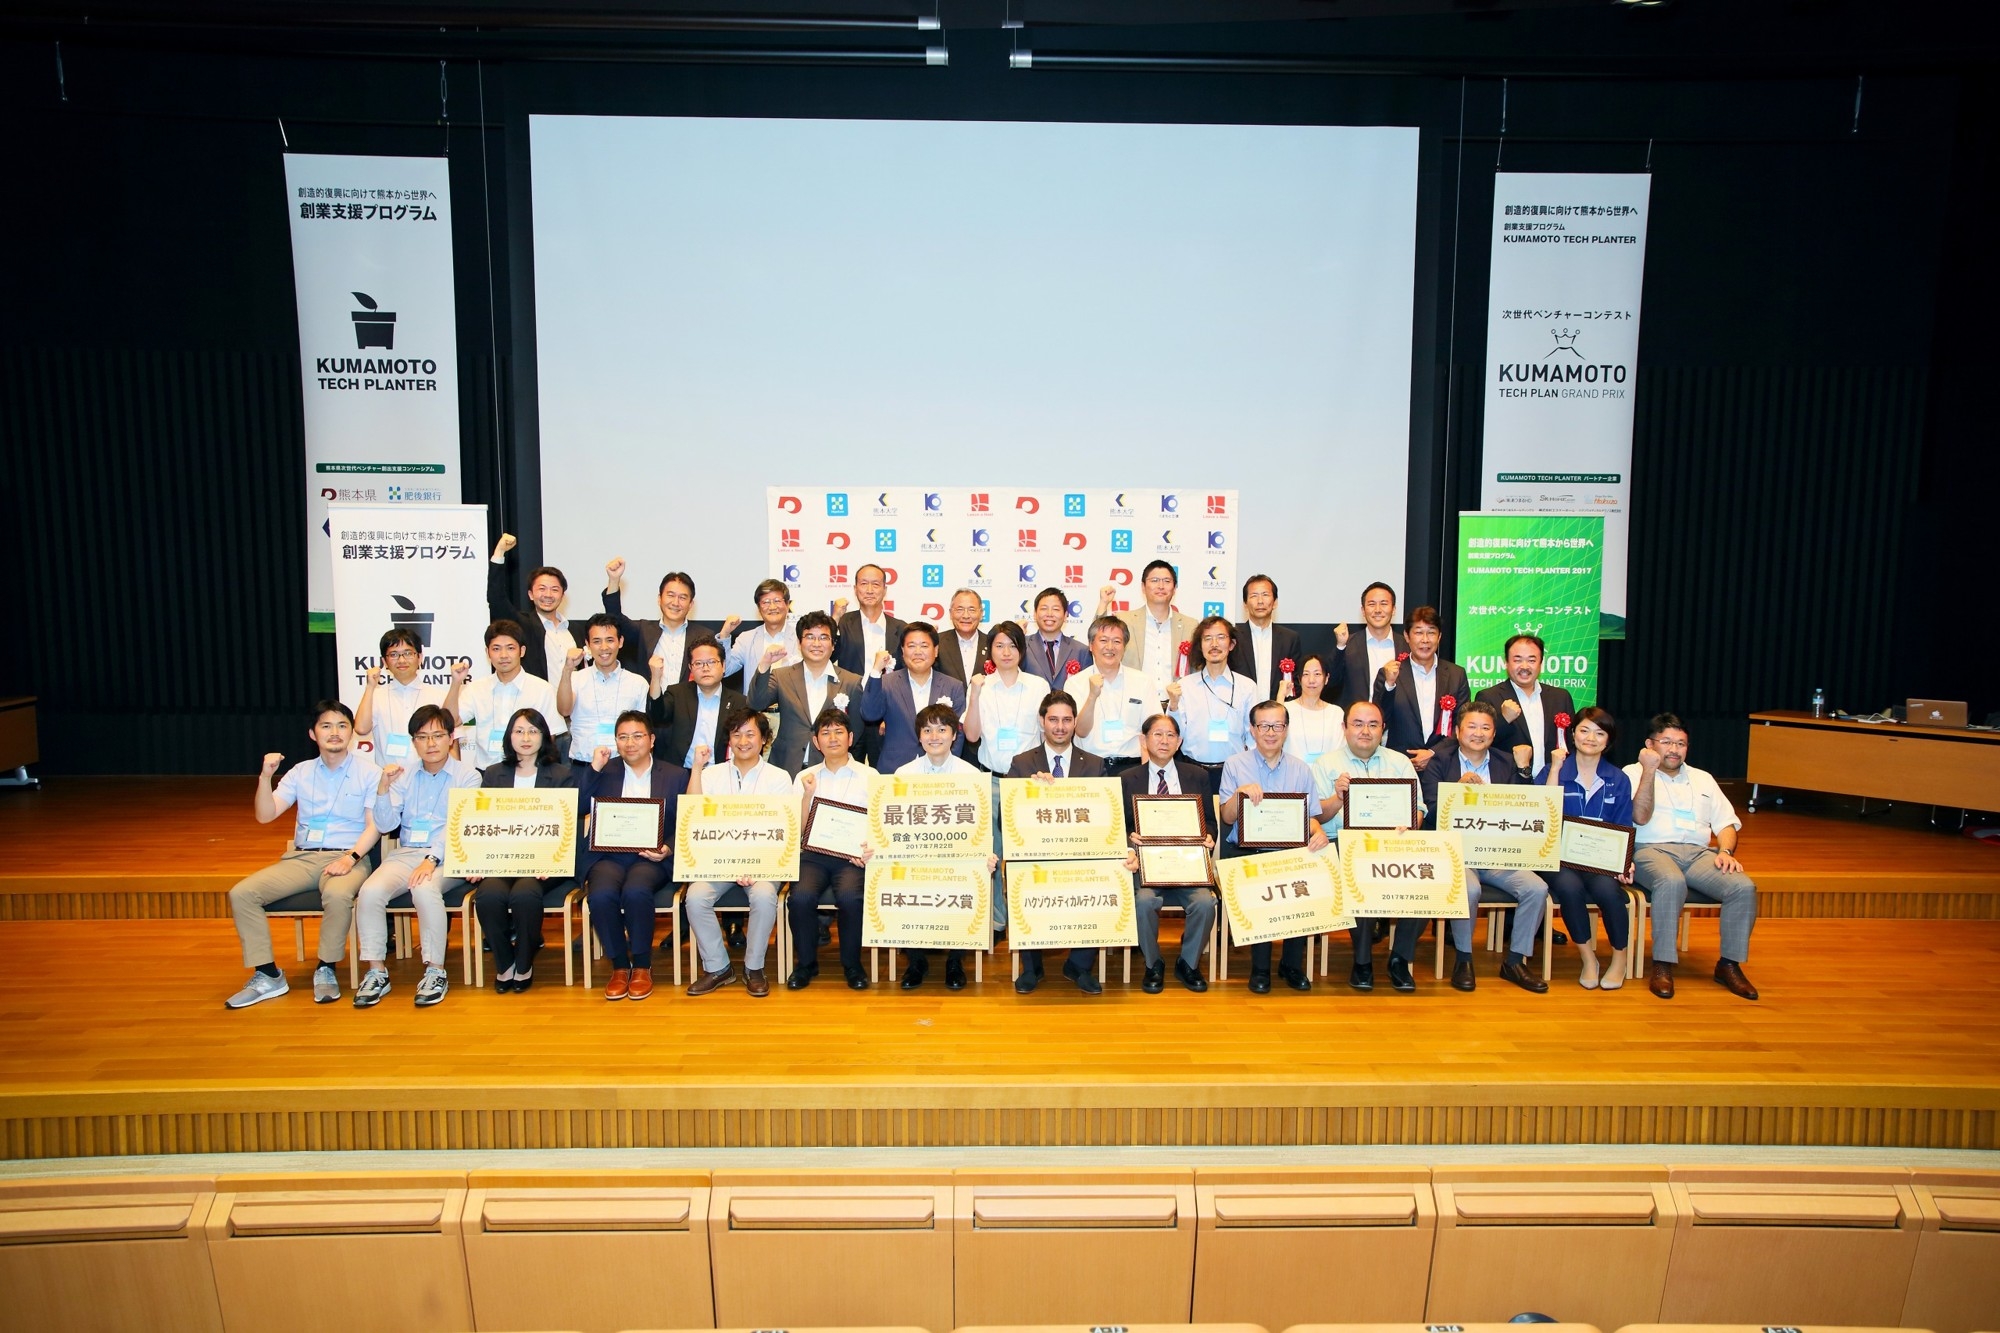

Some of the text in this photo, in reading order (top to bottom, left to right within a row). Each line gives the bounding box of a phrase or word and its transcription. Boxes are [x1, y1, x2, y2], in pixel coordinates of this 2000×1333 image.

[298, 187, 437, 200] 創造的復興に向けて熊本から世界へ
[300, 203, 437, 221] 創業支援プログラム
[1505, 205, 1638, 216] 創造的復興に向けて熊本から世界へ
[1504, 223, 1565, 231] 創業支援プログラム
[1503, 235, 1636, 244] KUMAMOTO TECH PLANTER
[1502, 310, 1632, 320] 次世代ベンチャーコンテスト
[317, 358, 437, 375] KUMAMOTO
[1499, 364, 1627, 383] KUMAMOTO
[318, 378, 437, 391] TECH PLANTER
[1499, 388, 1625, 399] TECH PLAN GRAND PRIX
[339, 489, 376, 501] 熊本県
[404, 491, 441, 500] 肥後銀行
[341, 531, 476, 541] 創造的復興に向けて熊本から世界へ
[1468, 538, 1594, 548] 創造的復興に向けて熊本から世界へ
[342, 544, 476, 560] 創業支援プログラム
[1468, 606, 1592, 615] 次世代ベンチャーコンテスト
[354, 656, 473, 671] KUMOTO
[356, 675, 393, 685] TCH
[1564, 679, 1587, 687] PRIX
[883, 803, 976, 825] 最優秀賞
[1036, 808, 1090, 824] 特別賞
[463, 824, 560, 837] あつまるホールディングス賞
[1453, 817, 1545, 833] エスケーホーム賞
[692, 828, 785, 841] オムロンベンチャーズ賞
[892, 831, 968, 842] 賞金 ¥300,000
[1474, 846, 1522, 854] 2017年7月22日
[1262, 857, 1303, 869] KUMAMOTO
[1264, 862, 1318, 876] TECH PLANTER
[1371, 862, 1435, 880] NOK賞
[1261, 880, 1311, 902] JT賞
[880, 893, 973, 909] 日本ユニシス賞
[1268, 911, 1315, 924] 2017年7月22日
